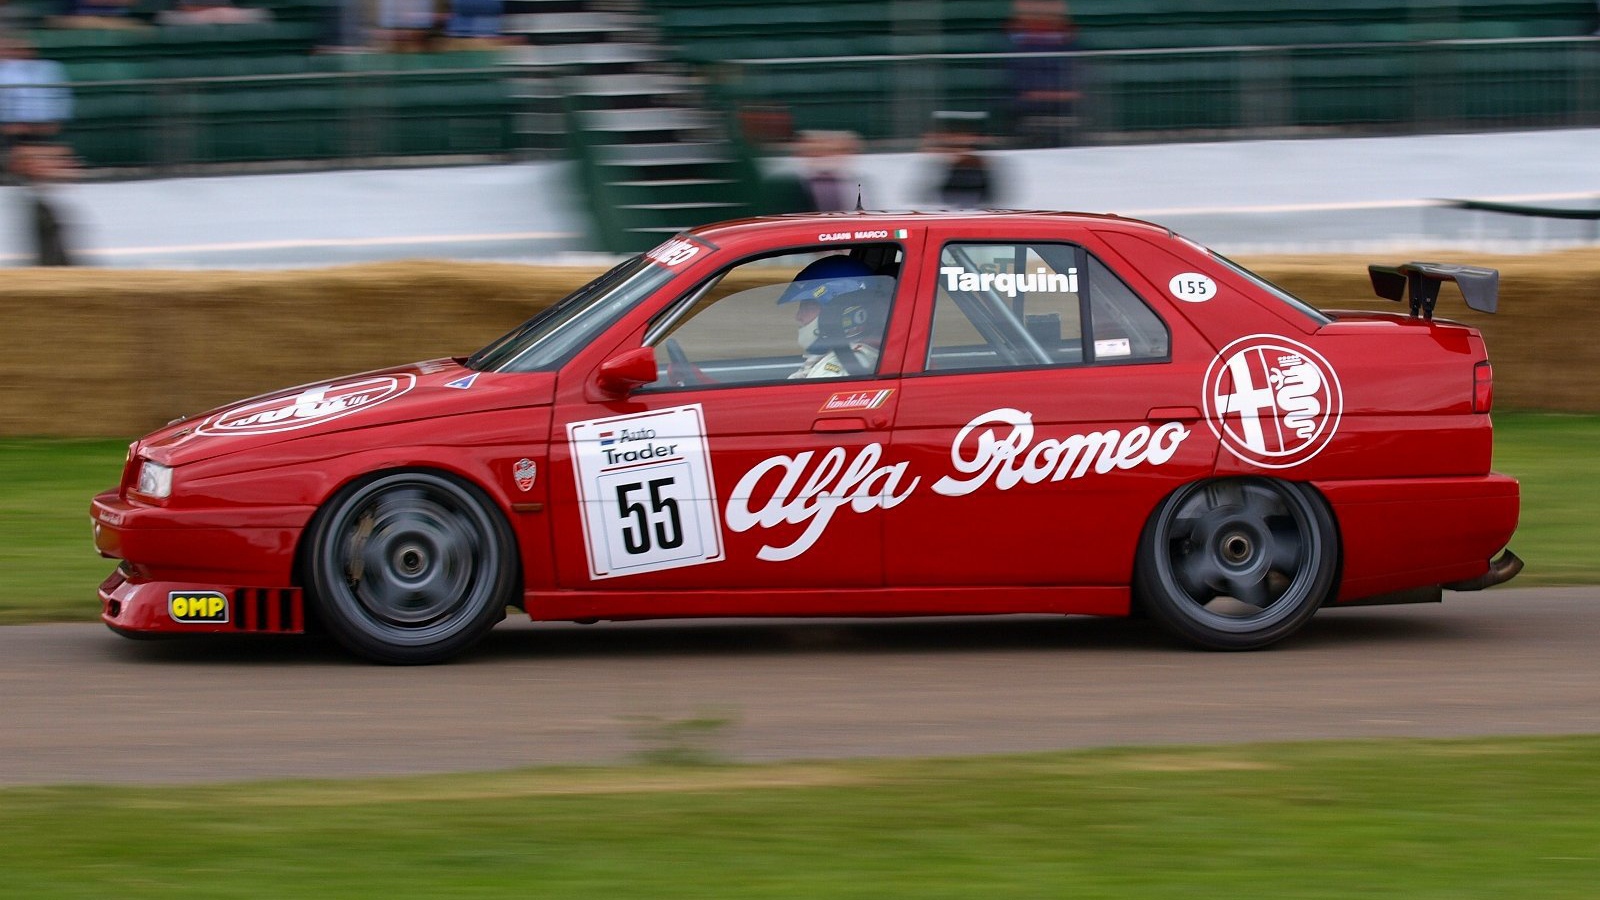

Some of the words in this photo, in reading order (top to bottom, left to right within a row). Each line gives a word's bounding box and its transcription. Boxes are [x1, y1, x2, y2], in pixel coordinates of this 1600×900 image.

[854, 230, 888, 239] MARCO
[940, 266, 1079, 297] Tarquini
[1178, 280, 1206, 294] 155
[620, 427, 656, 444] Auto
[602, 443, 678, 464] Trader
[725, 442, 922, 562] Alfa
[931, 407, 1190, 496] Romeo
[616, 477, 684, 554] 55
[172, 597, 225, 617] OMP
